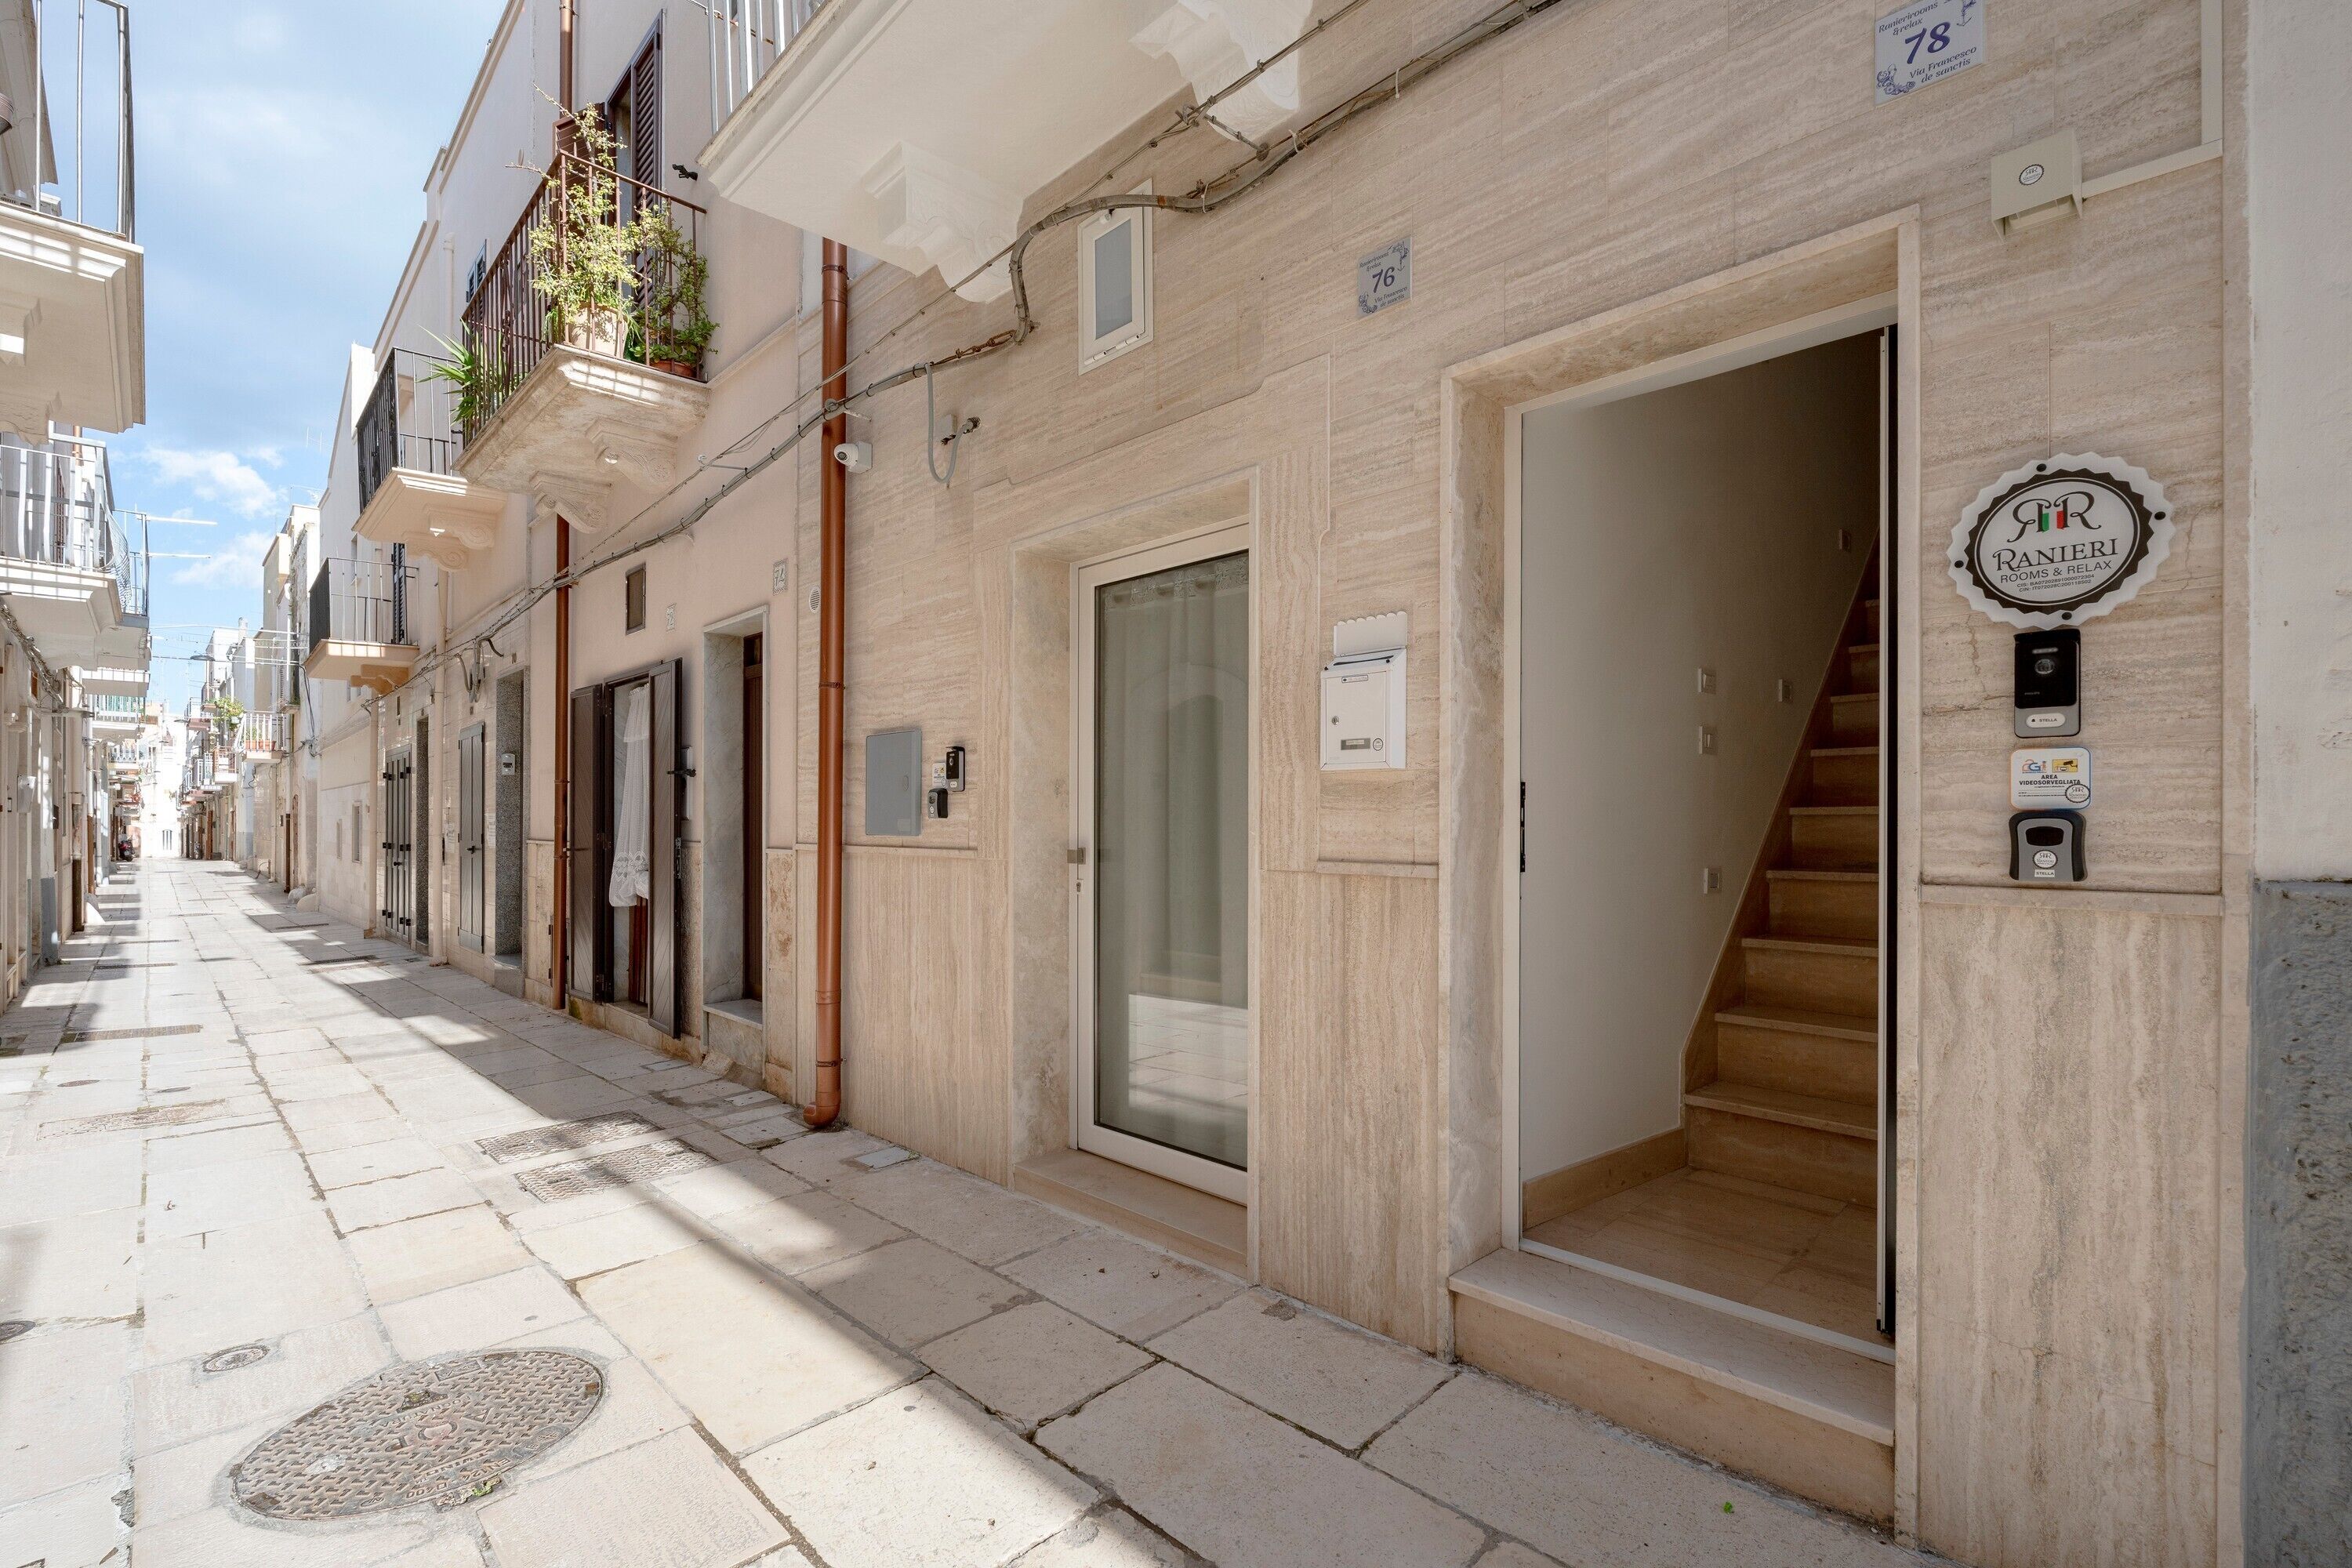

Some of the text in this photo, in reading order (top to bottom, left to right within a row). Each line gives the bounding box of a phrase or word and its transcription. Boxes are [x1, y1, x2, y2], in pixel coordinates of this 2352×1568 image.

[1878, 2, 1938, 33] Ranierirooms
[1893, 18, 1923, 35] &relax
[1904, 21, 1951, 64] 78
[1909, 46, 1976, 78] Via Francesco
[1921, 58, 1971, 83] de sanctis
[1372, 267, 1396, 293] 76
[1992, 539, 2118, 572] RANIERI
[2001, 561, 2112, 583] ROOMS & RELAX
